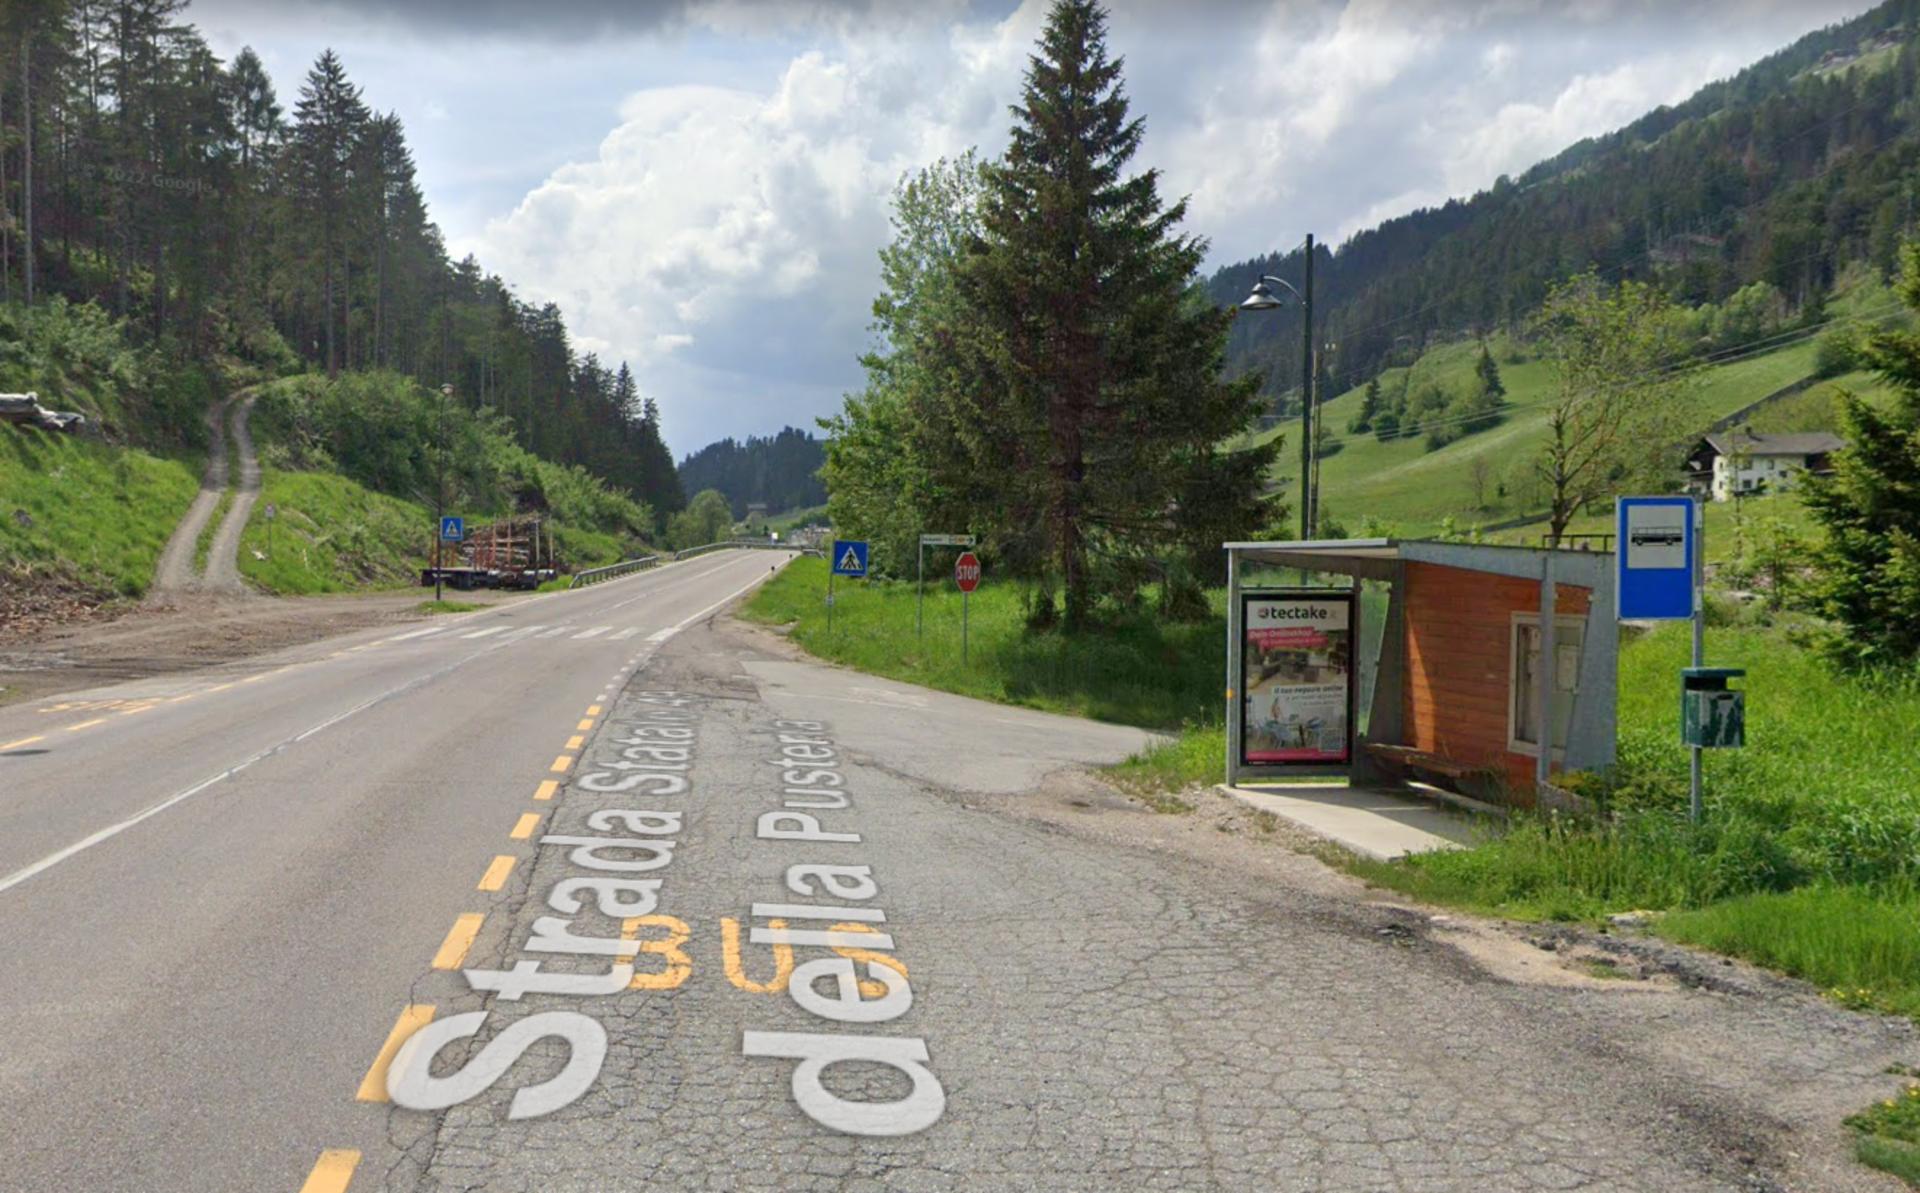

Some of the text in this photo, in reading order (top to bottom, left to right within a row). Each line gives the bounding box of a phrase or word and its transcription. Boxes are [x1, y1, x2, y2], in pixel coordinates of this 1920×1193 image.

[957, 566, 980, 580] STOP
[1271, 605, 1328, 619] tectake
[612, 915, 910, 998] BUS
